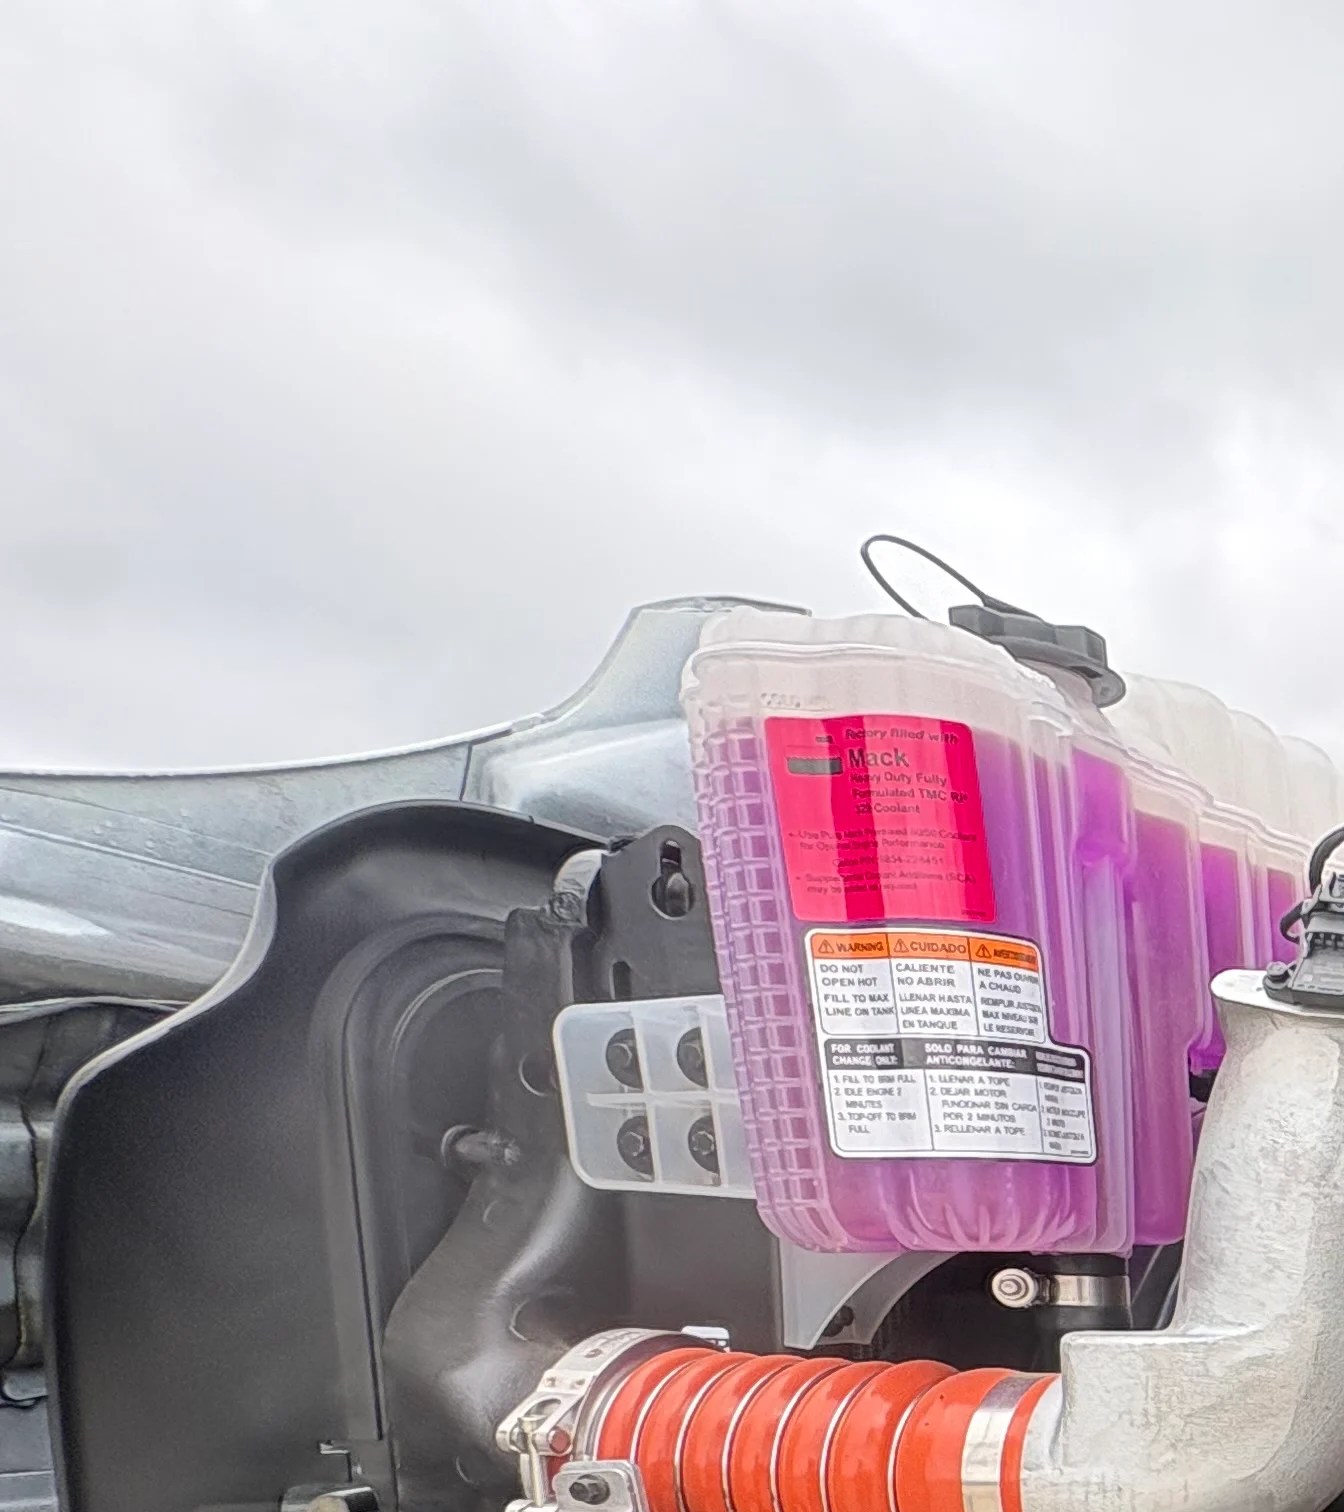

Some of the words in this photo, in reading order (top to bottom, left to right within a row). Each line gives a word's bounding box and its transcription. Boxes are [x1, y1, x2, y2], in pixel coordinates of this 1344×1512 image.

[845, 728, 887, 740] Factory
[890, 728, 924, 739] filled
[929, 732, 958, 744] with
[849, 748, 910, 768] Mack
[884, 772, 912, 784] Duty
[917, 773, 947, 787] Fully
[853, 789, 915, 799] Formulated
[919, 789, 946, 801] TMC
[874, 803, 920, 814] Coolant
[836, 941, 884, 953] WARNING
[910, 942, 967, 954] CUIDADO
[820, 965, 838, 973] DO
[842, 964, 863, 973] NOT
[895, 963, 955, 974] CALIENTE
[978, 968, 991, 977] NE
[994, 969, 1012, 979] PAS
[822, 977, 855, 987] OPEN
[858, 977, 878, 987] HOT
[898, 977, 914, 986] NO
[917, 977, 956, 987] ABRIR
[824, 994, 849, 1003] FILL
[852, 994, 866, 1003] TO
[869, 994, 889, 1002] MAX
[899, 992, 936, 1003] LLENAR
[938, 994, 973, 1004] HASTA
[825, 1007, 852, 1016] LINE
[917, 1020, 958, 1030] TANQUE
[831, 1044, 852, 1053] FOR
[856, 1044, 895, 1054] COOLANT
[924, 1043, 953, 1054] SOLO
[956, 1044, 984, 1055] PARA
[832, 1056, 872, 1066] CHANGE
[974, 1087, 1008, 1098] MOTOR
[943, 1111, 964, 1122] POR
